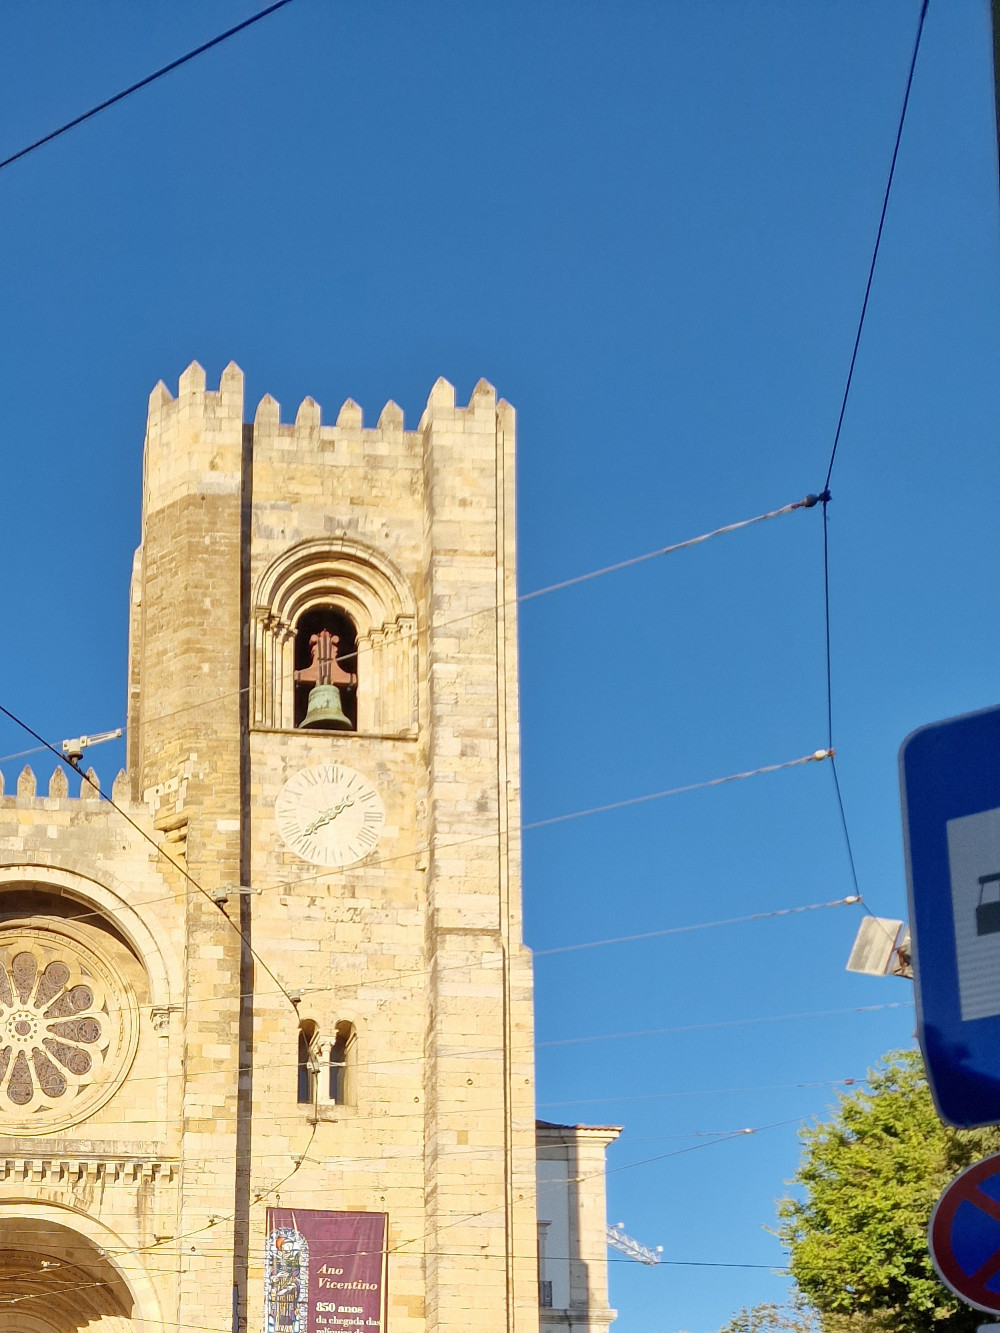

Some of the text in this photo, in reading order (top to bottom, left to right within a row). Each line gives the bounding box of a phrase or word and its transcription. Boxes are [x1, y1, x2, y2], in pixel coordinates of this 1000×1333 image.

[317, 1264, 344, 1275] Ano
[318, 1278, 378, 1290] Vicentino
[316, 1302, 335, 1312] 850
[315, 1315, 327, 1324] da
[328, 1316, 364, 1327] chegada
